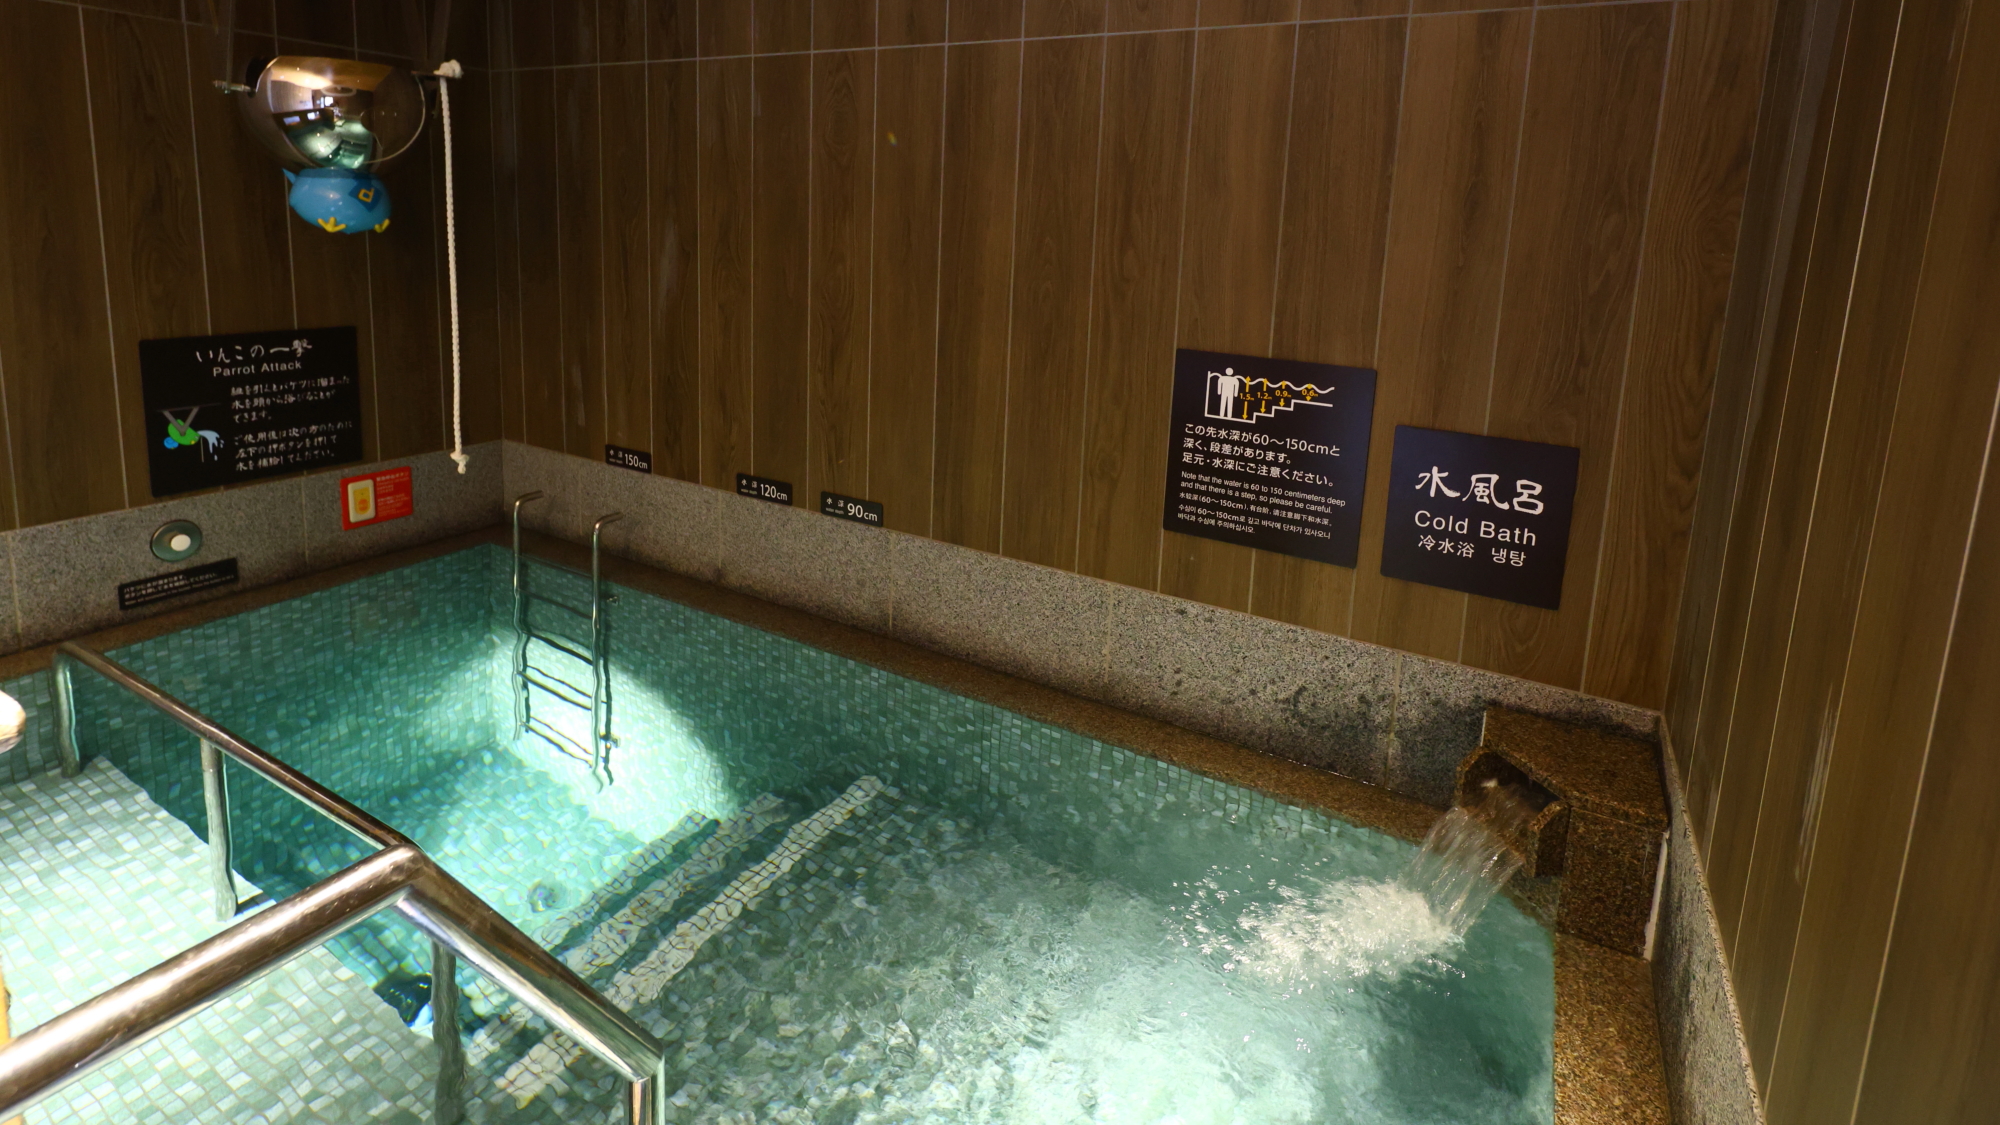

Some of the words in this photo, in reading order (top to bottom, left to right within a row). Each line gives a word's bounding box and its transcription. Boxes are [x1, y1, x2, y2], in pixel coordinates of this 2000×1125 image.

[196, 339, 312, 363] いんこの一撃
[213, 364, 256, 377] Parrot
[261, 360, 302, 373] Attack
[624, 453, 648, 469] 150cm
[1183, 437, 1292, 465] 深く、段差があります。
[1182, 451, 1334, 487] 足元・水深にご注意ください。
[760, 483, 788, 501] 120cm
[1180, 481, 1193, 489] and
[1194, 482, 1207, 491] that
[1208, 485, 1226, 494] there
[1227, 488, 1233, 496] is
[1241, 491, 1257, 501] step,
[1269, 496, 1293, 507] please
[1295, 500, 1304, 509] be
[1305, 503, 1333, 514] careful.
[1181, 470, 1197, 480] Note
[1197, 474, 1210, 482] that
[1211, 476, 1222, 484] the
[1224, 479, 1242, 488] water
[1243, 481, 1250, 489] is
[1250, 483, 1260, 491] 60
[1261, 485, 1269, 493] to
[1270, 486, 1283, 495] 150
[1284, 490, 1326, 503] centimeters
[1327, 497, 1346, 507] deep
[1415, 465, 1544, 515] 水風呂
[847, 502, 878, 522] 90cm
[1177, 512, 1196, 522] 바닥과
[1178, 504, 1197, 514] 수심이
[1261, 519, 1282, 529] 바닥에
[1414, 510, 1469, 535] Cold
[1480, 520, 1537, 547] Bath
[1418, 534, 1475, 559] 冷水浴
[1491, 547, 1527, 567] 냉탕
